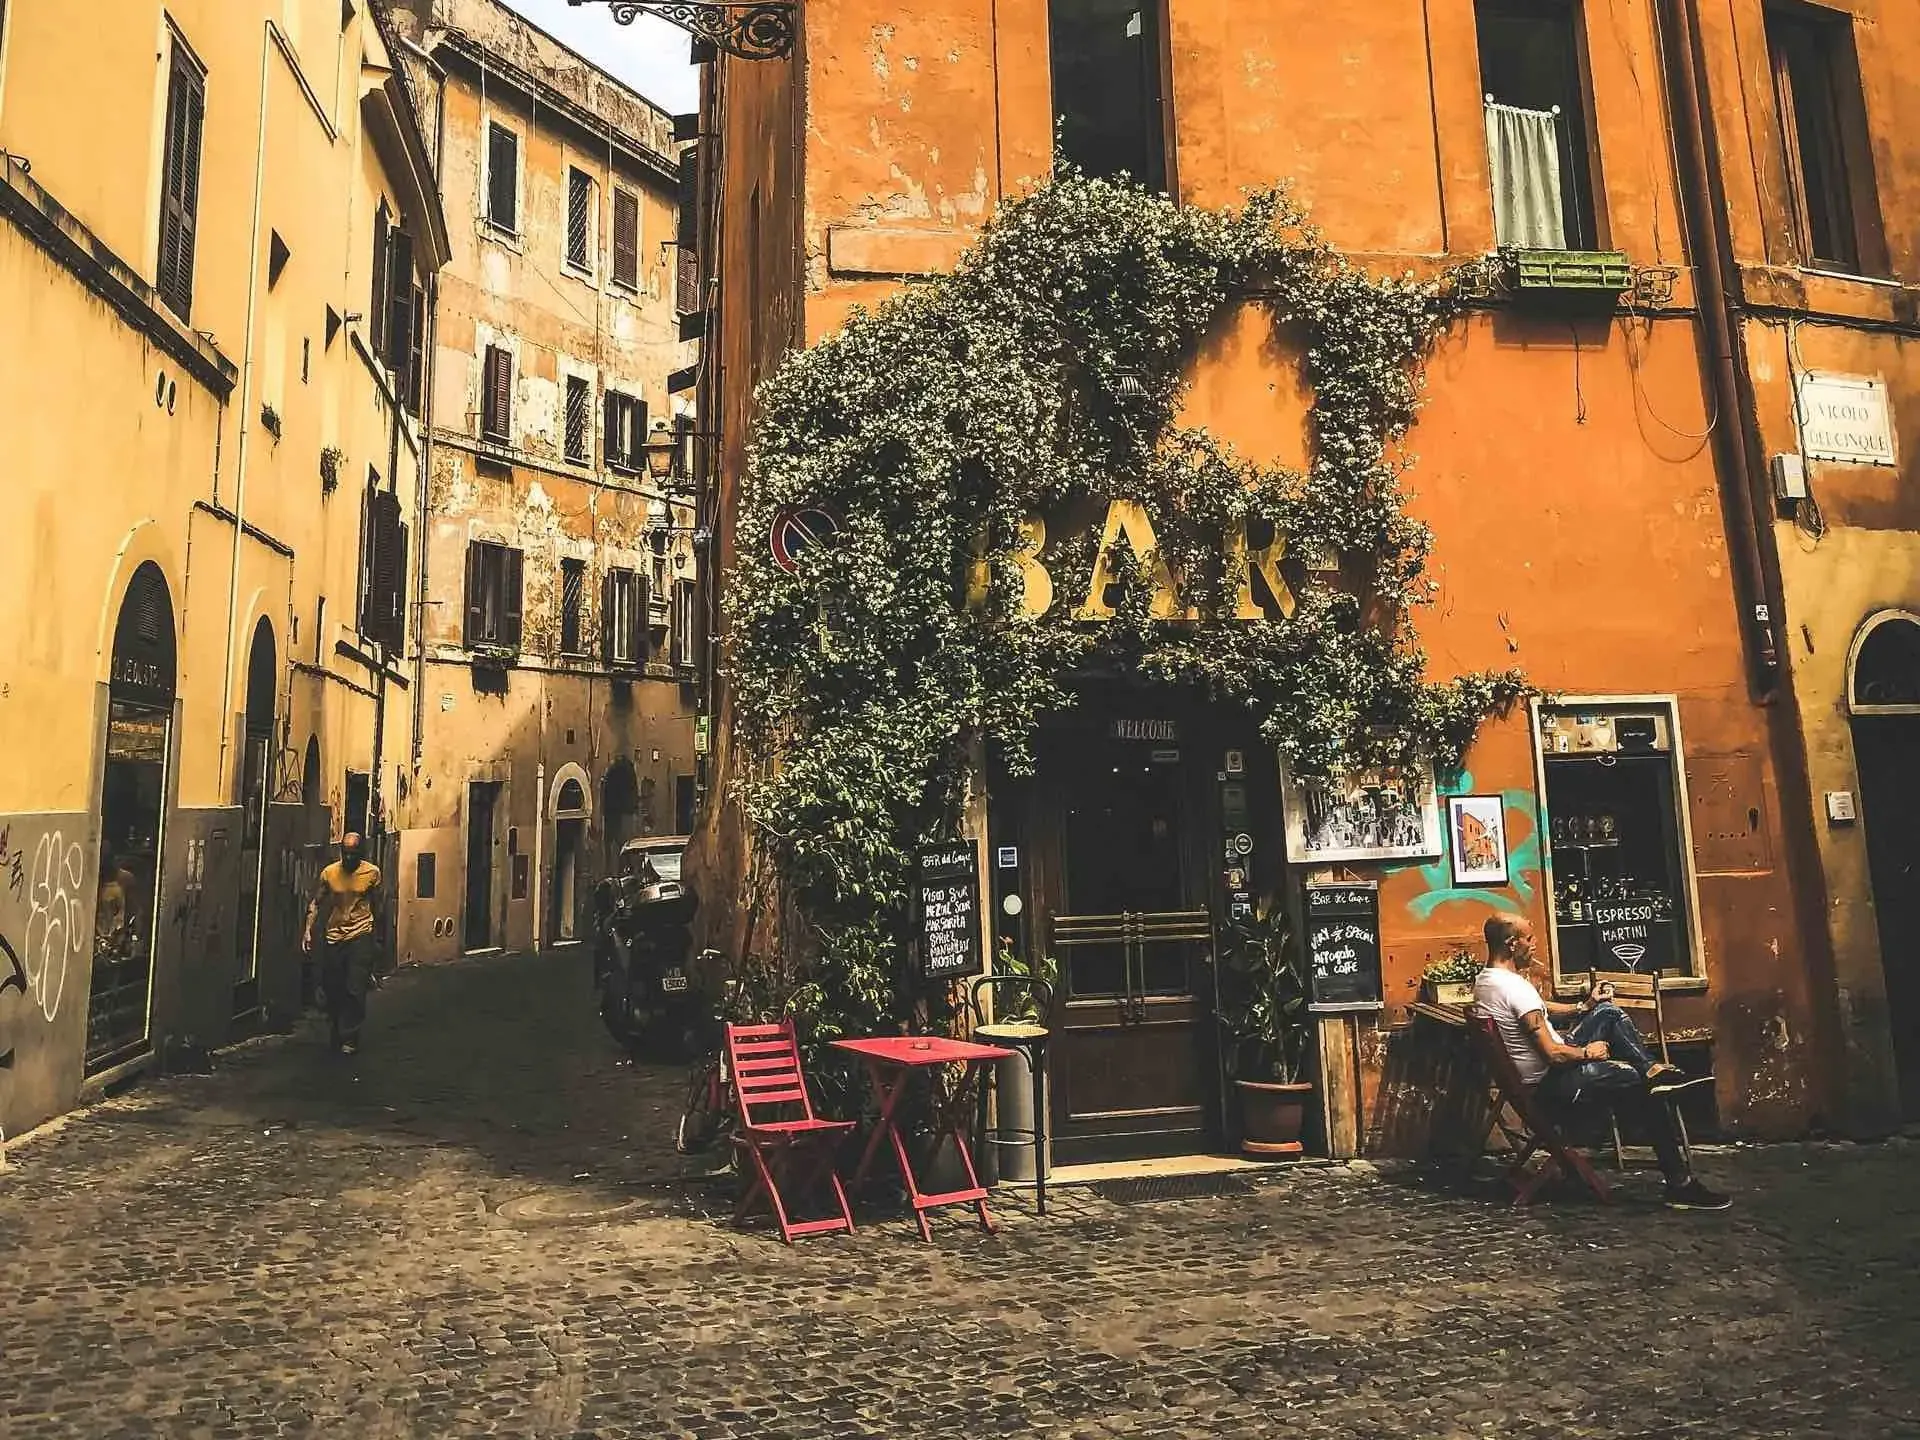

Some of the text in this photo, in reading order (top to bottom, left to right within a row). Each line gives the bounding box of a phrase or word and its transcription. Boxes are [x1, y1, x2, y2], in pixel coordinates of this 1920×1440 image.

[1817, 403, 1869, 422] VICOLO
[1835, 432, 1887, 452] CINQUE
[965, 499, 1297, 621] BAR
[1113, 719, 1176, 740] WELCOME
[1360, 775, 1380, 785] BAR
[1595, 905, 1652, 924] ESPRESSO
[1602, 925, 1648, 943] MARTINI
